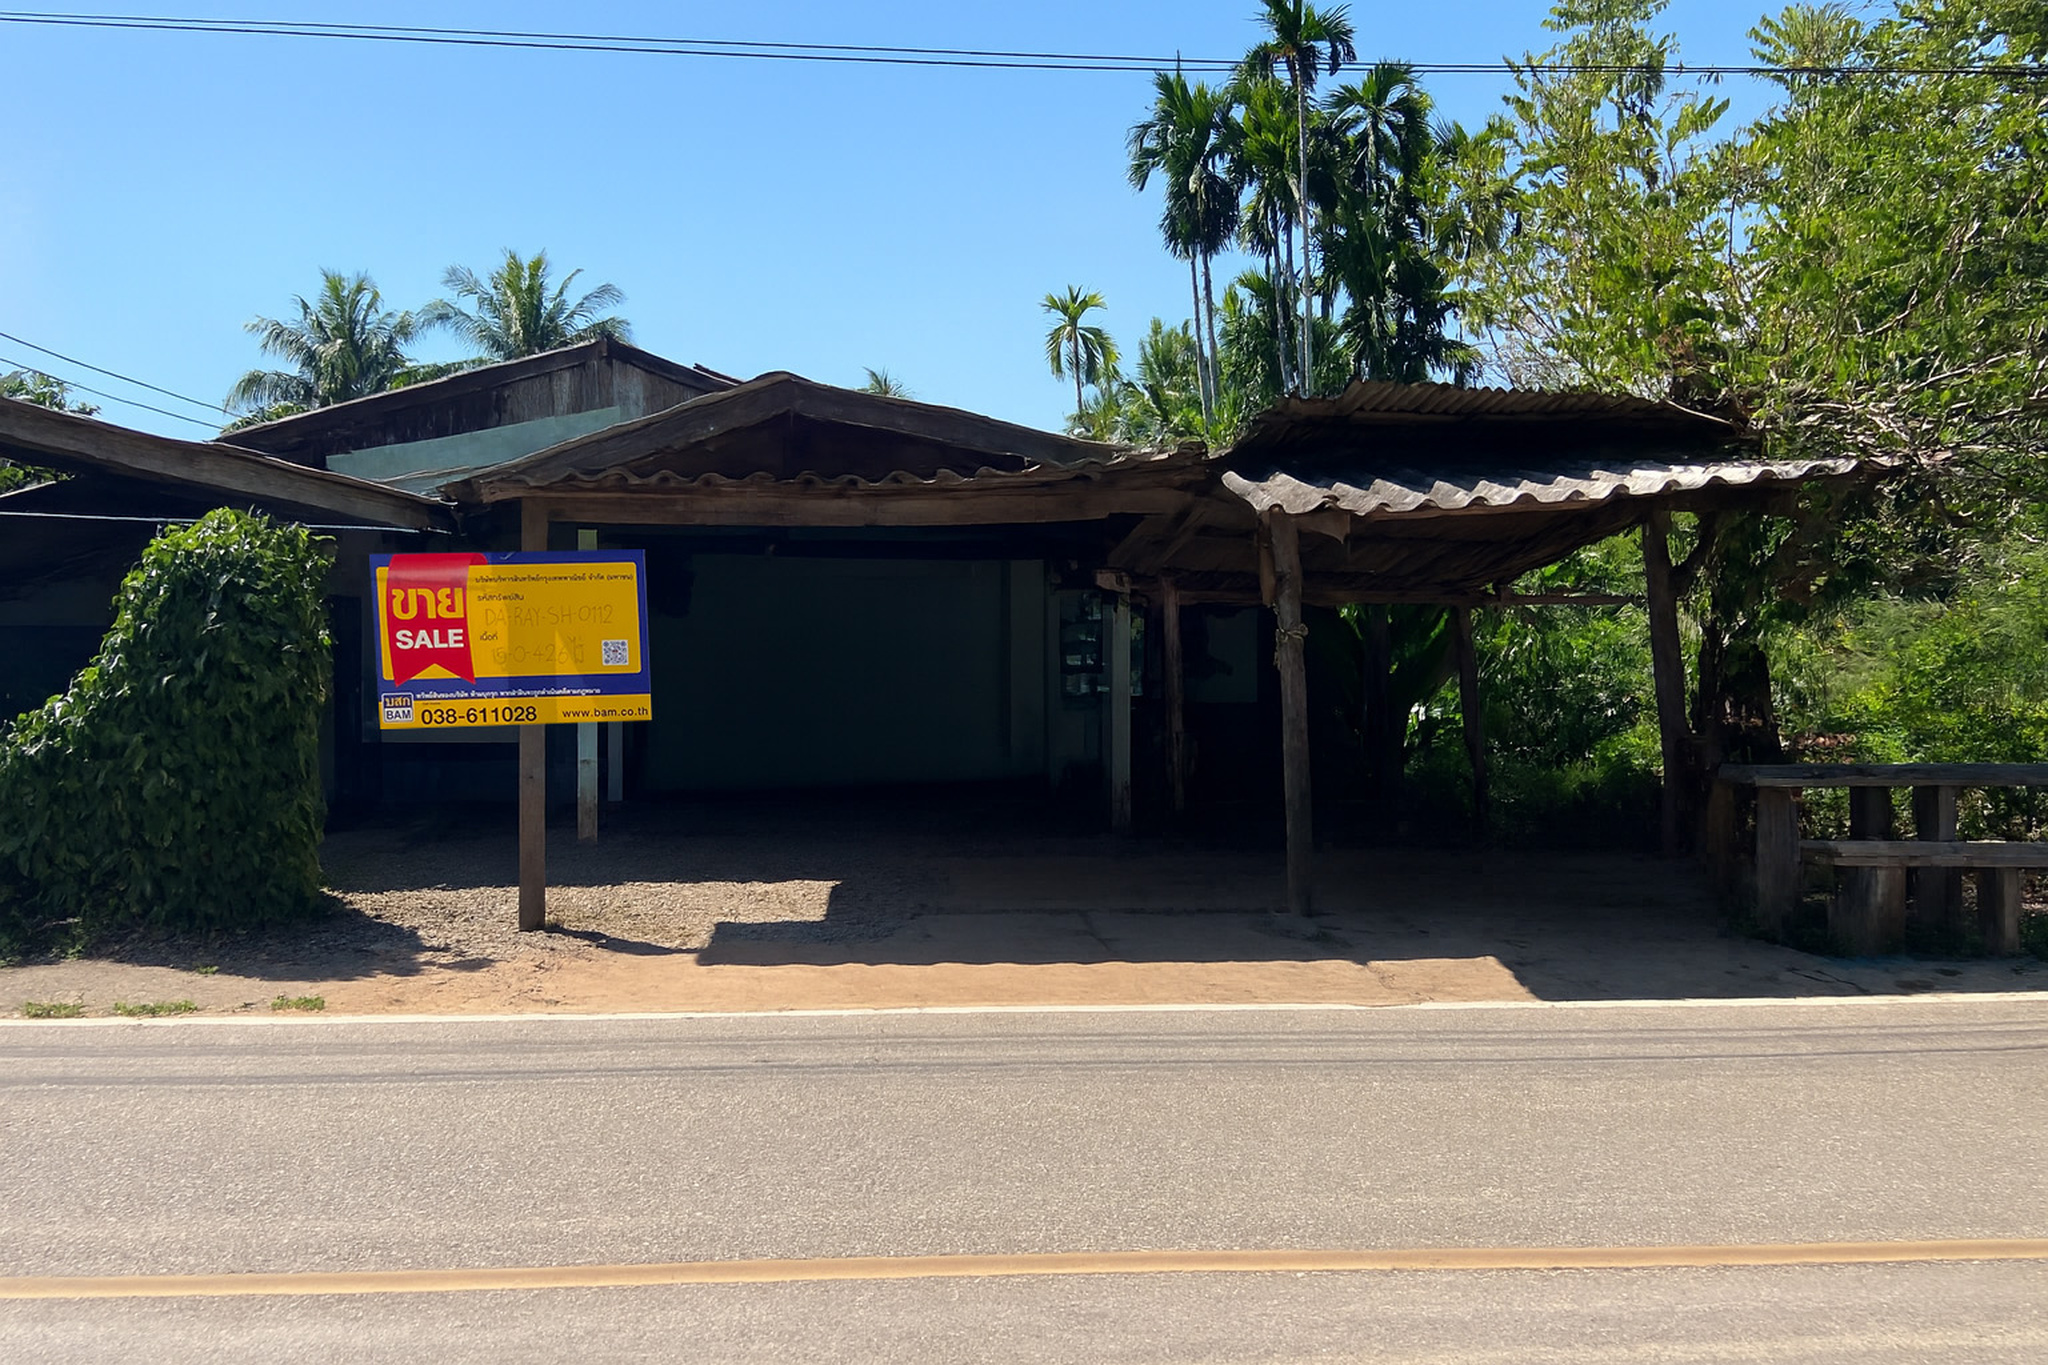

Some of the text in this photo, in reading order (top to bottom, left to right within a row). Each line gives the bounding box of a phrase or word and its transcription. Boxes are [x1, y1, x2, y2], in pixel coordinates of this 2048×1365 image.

[391, 587, 464, 620] ขาย
[395, 629, 464, 650] SALE
[385, 696, 411, 707] บสก
[386, 709, 412, 720] BAM
[421, 705, 538, 725] 038-611028
[562, 707, 649, 718] www.bam.co.th
